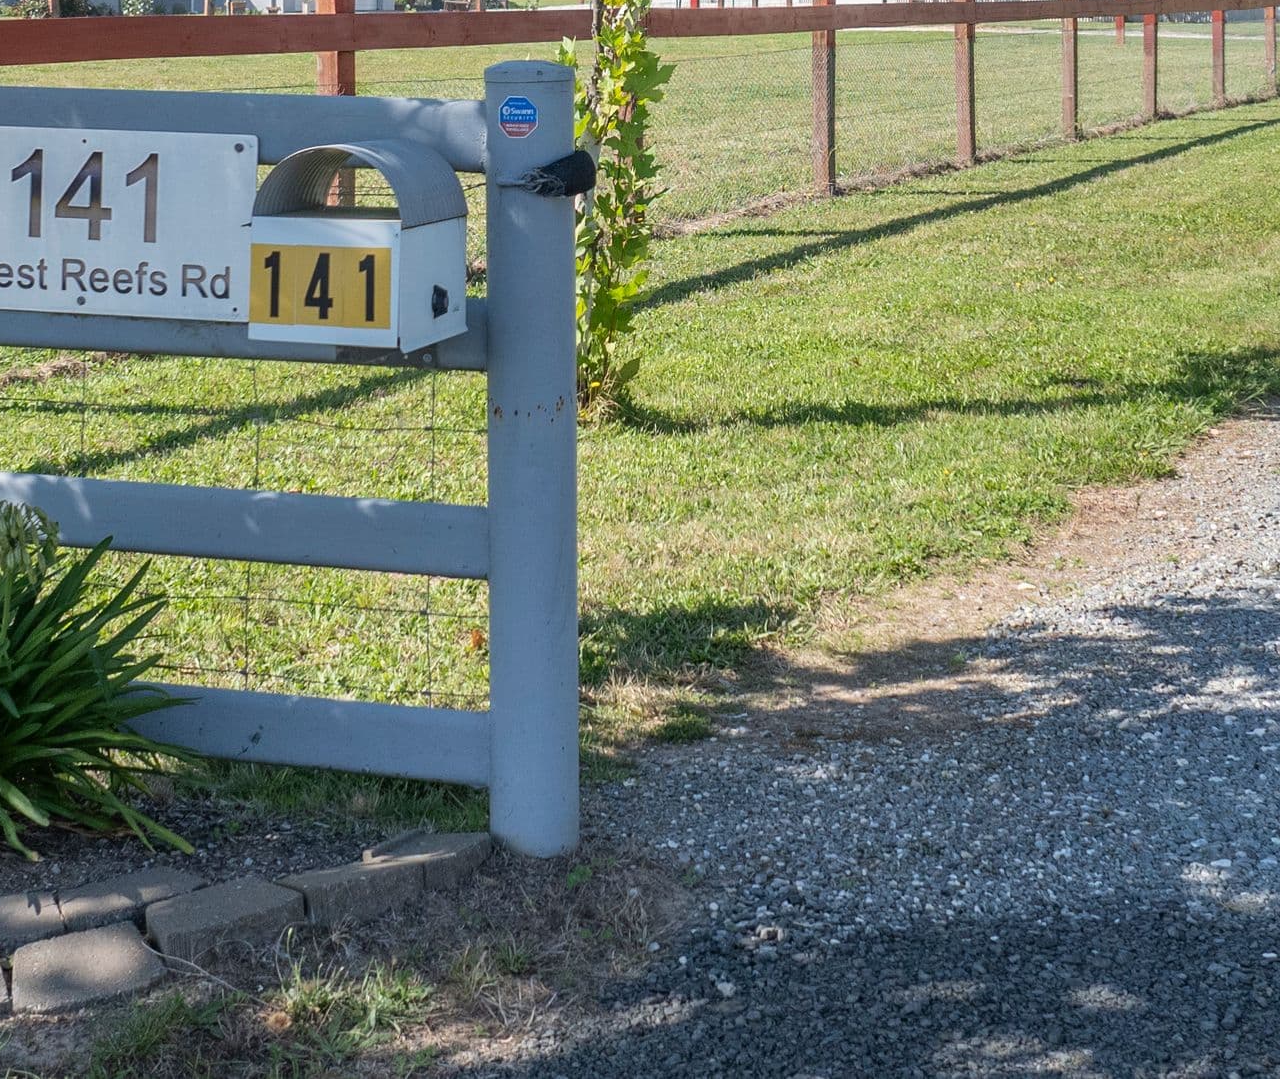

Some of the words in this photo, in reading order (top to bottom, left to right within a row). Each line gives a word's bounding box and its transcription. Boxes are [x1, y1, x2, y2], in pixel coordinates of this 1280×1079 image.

[11, 148, 160, 243] 141
[61, 258, 168, 297] Reefs
[181, 264, 231, 300] Rd
[264, 251, 376, 322] 141
